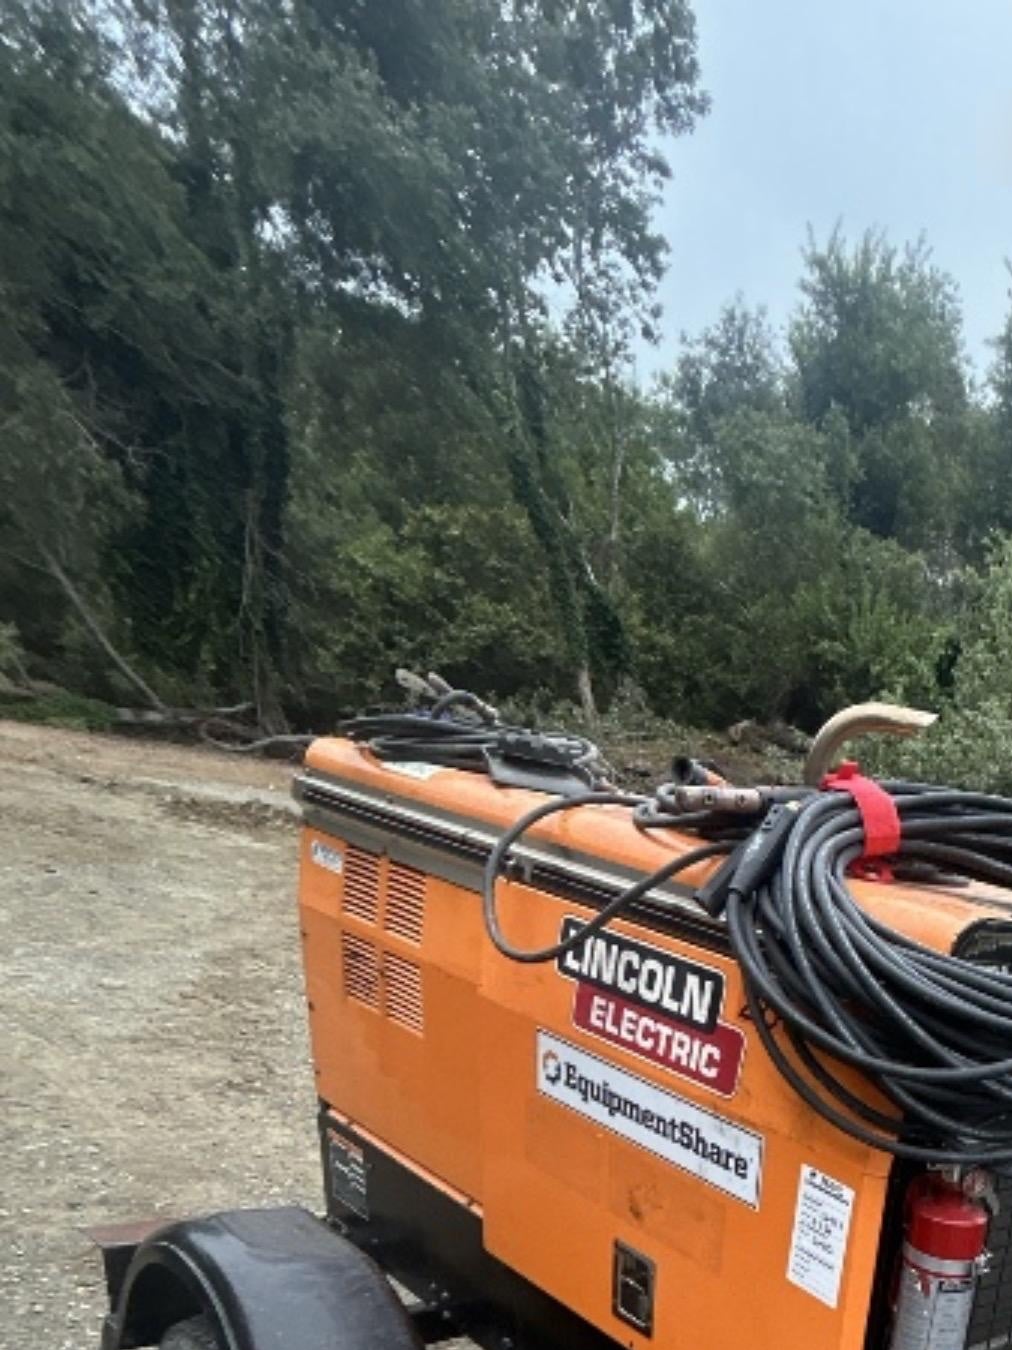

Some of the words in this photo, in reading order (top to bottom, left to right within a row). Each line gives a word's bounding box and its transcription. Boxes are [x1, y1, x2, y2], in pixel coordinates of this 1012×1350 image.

[563, 928, 713, 1024] LINCOLN
[589, 995, 721, 1079] ELECTRIC
[562, 1061, 749, 1180] EquipmentShare
